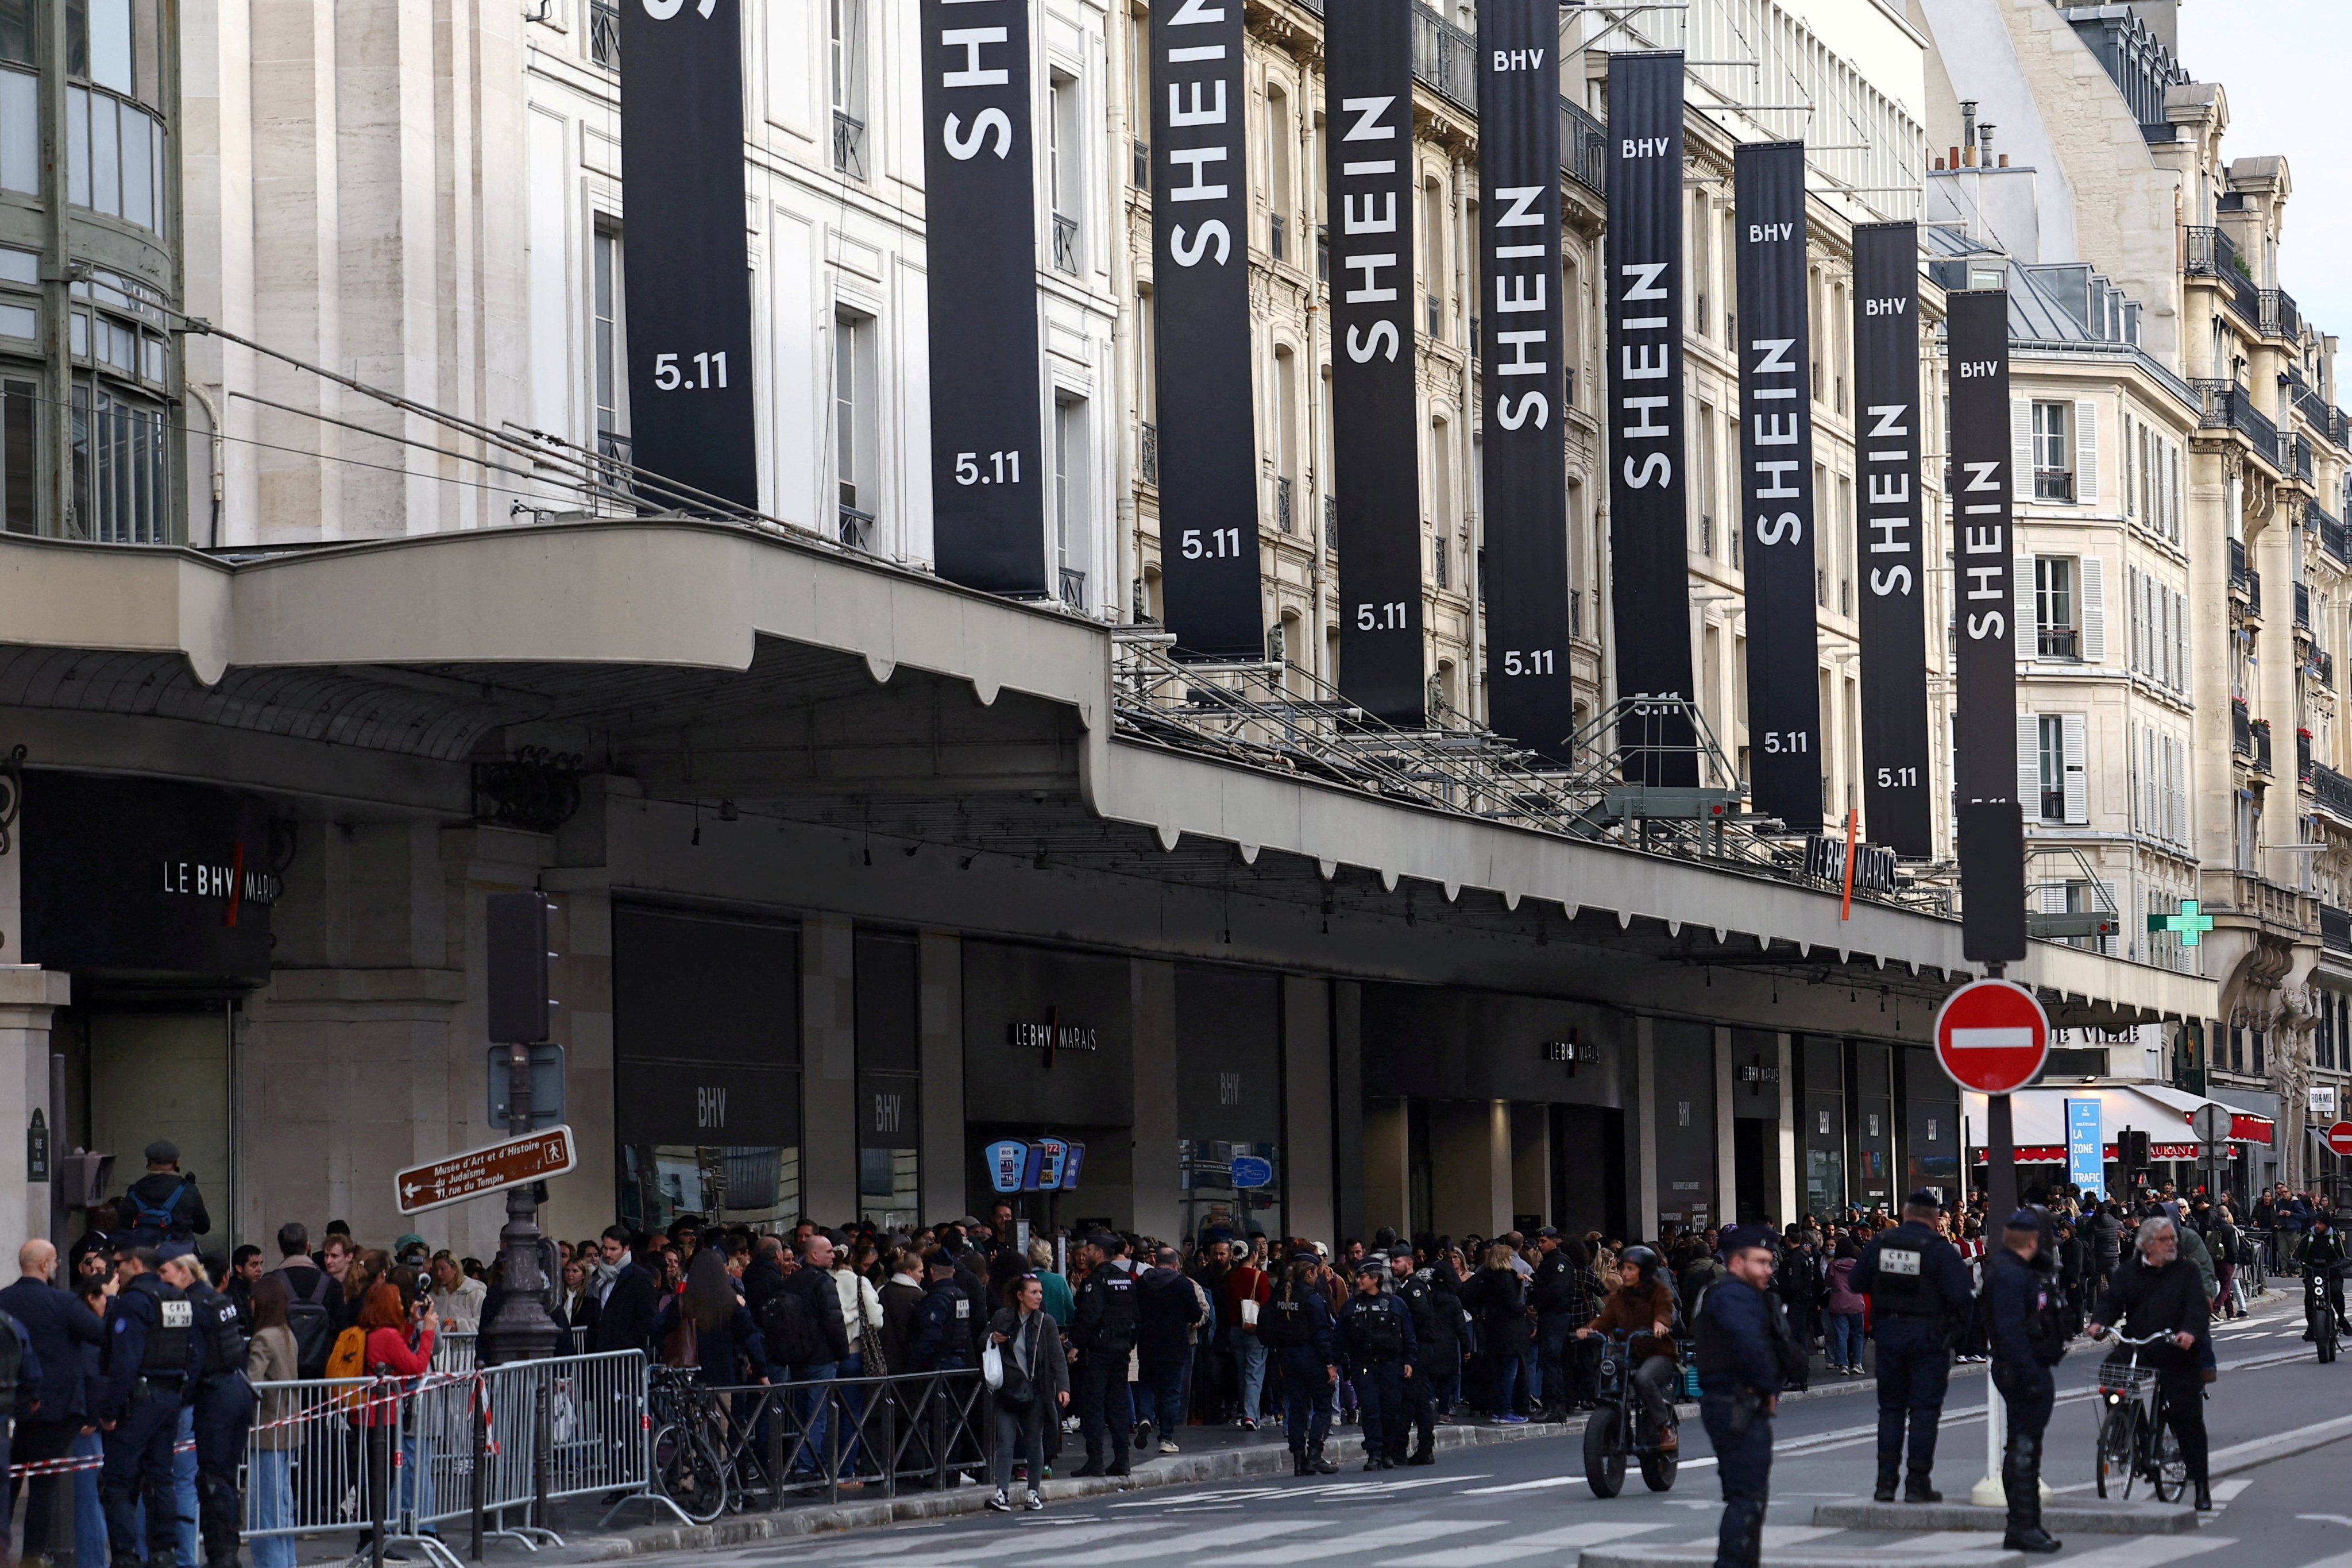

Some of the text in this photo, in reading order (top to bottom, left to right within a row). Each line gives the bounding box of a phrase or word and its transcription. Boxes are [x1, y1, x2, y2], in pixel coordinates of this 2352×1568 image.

[1493, 48, 1544, 72] BHV
[941, 0, 1012, 160] SH
[1622, 137, 1669, 159] BHV
[1342, 96, 1399, 363] SHEIN
[1749, 223, 1793, 242] BHV
[1495, 186, 1549, 431] SHEIN
[1866, 298, 1907, 316] BHV
[655, 352, 728, 391] 5.11
[1621, 262, 1671, 489] SHEIN
[1960, 361, 1998, 379] BHV
[1752, 338, 1802, 546] SHEIN
[955, 450, 1020, 485] 5.11
[1867, 404, 1912, 597] SHEIN
[1181, 528, 1241, 559] 5.11
[1964, 461, 2005, 640] SHEIN
[1357, 602, 1406, 631] 5.11
[1504, 649, 1553, 676] 5.11
[1764, 731, 1808, 754] 5.11
[1878, 767, 1917, 787] 5.11
[1810, 836, 1824, 877] LE
[1855, 846, 1898, 895] MARAIS
[164, 861, 189, 894] LE
[198, 864, 234, 899] BHV
[1016, 1023, 1096, 1051] LE BHV MARAIS
[1551, 1042, 1559, 1060] LE
[1748, 1066, 1759, 1082] BHV
[1221, 1073, 1239, 1105] BHV
[2311, 1094, 2318, 1103] BO
[2323, 1093, 2333, 1103] MIE
[698, 1087, 726, 1128] BHV
[876, 1094, 901, 1131] BHV
[1678, 1102, 1690, 1126] BHV
[1820, 1111, 1829, 1134] BHV
[1870, 1114, 1879, 1137] BHV
[1928, 1119, 1937, 1141] BHV
[2073, 1129, 2083, 1139] LA
[434, 1140, 540, 1177] Musée d'Art et d'Histoire
[1048, 1144, 1059, 1152] 72
[2073, 1143, 2094, 1154] ZONE
[2074, 1155, 2080, 1168] À
[435, 1167, 485, 1187] du Judaïsme
[465, 1181, 474, 1191] du
[477, 1173, 505, 1188] Temple
[1042, 1171, 1052, 1180] 96
[2074, 1172, 2101, 1183] TRAFIC
